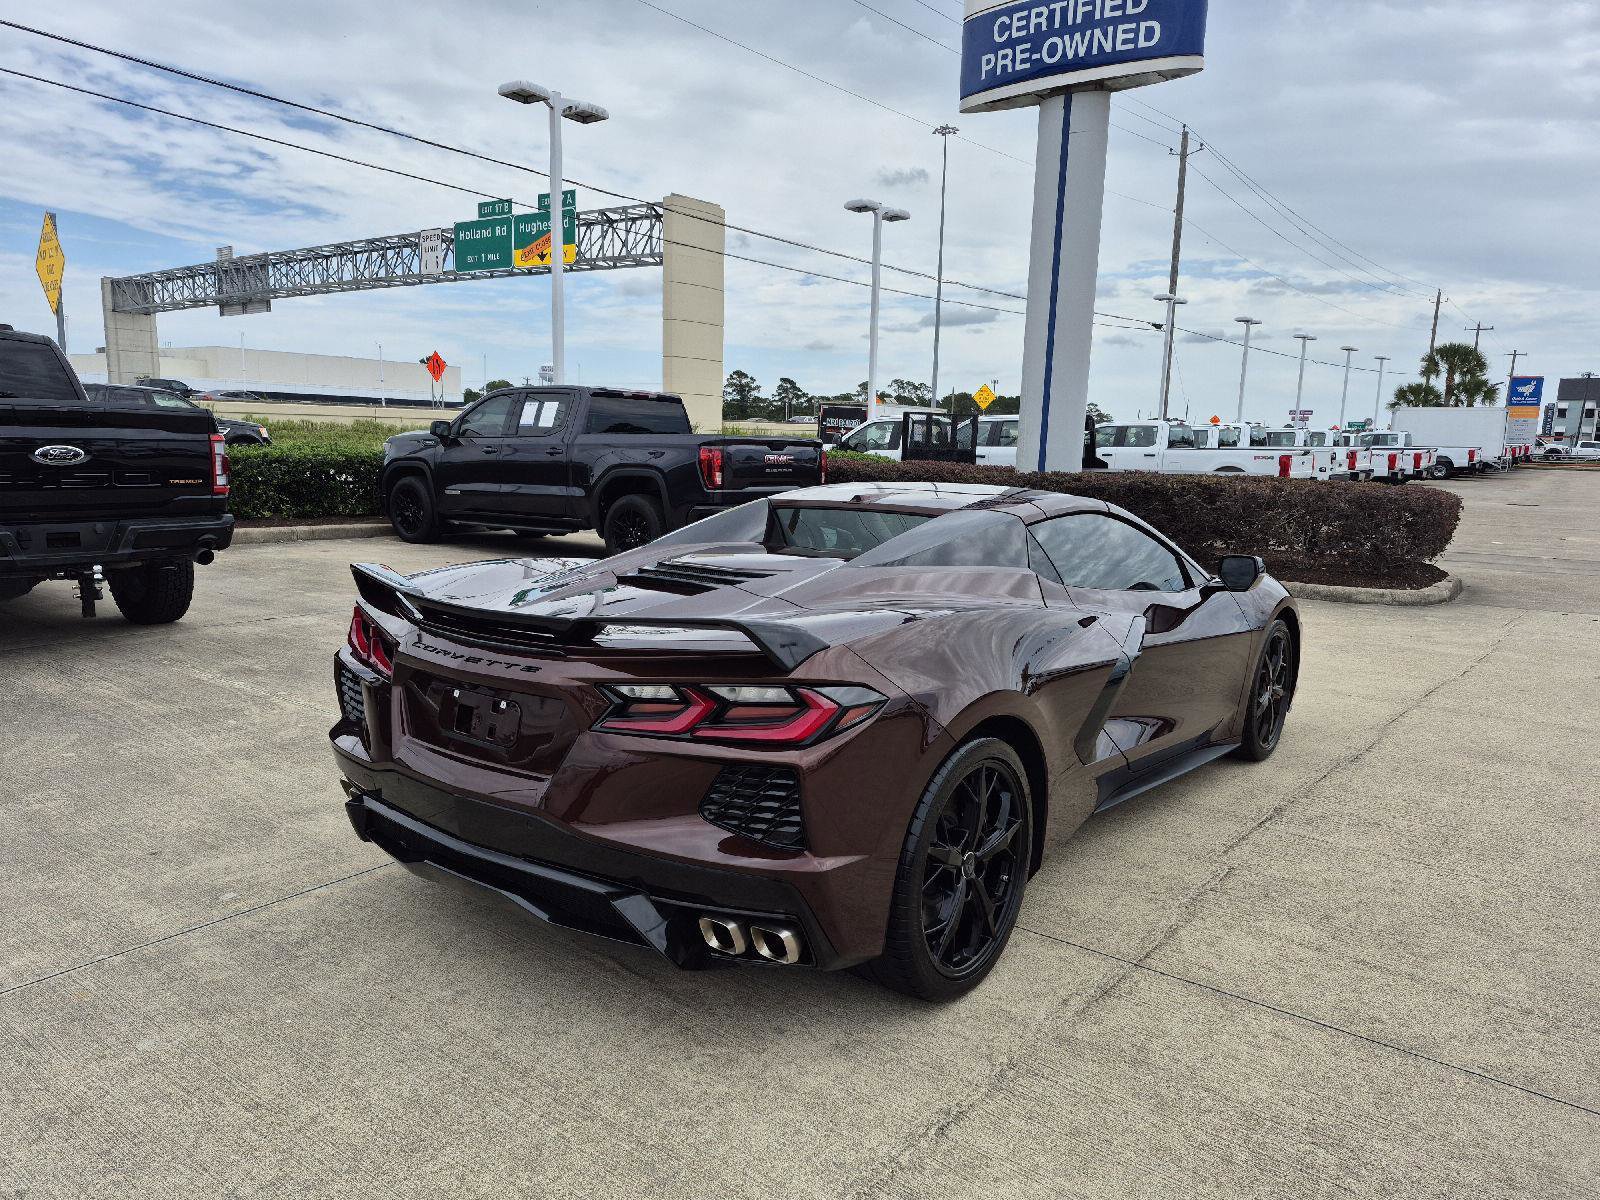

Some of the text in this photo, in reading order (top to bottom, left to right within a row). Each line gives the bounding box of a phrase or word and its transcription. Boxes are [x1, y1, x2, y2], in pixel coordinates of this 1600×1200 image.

[993, 0, 1147, 43] CERTIFIED
[981, 20, 1161, 80] PRE-OWNED
[482, 205, 492, 214] EXIT
[422, 234, 440, 242] SPEED
[460, 225, 506, 240] Holland Rd
[425, 244, 438, 254] LIMIT
[536, 236, 551, 250] CLOSE
[482, 254, 486, 262] 1
[488, 252, 500, 261] MILE
[48, 448, 73, 460] Ford
[765, 454, 794, 464] GMC
[412, 641, 542, 673] CORVETTE
